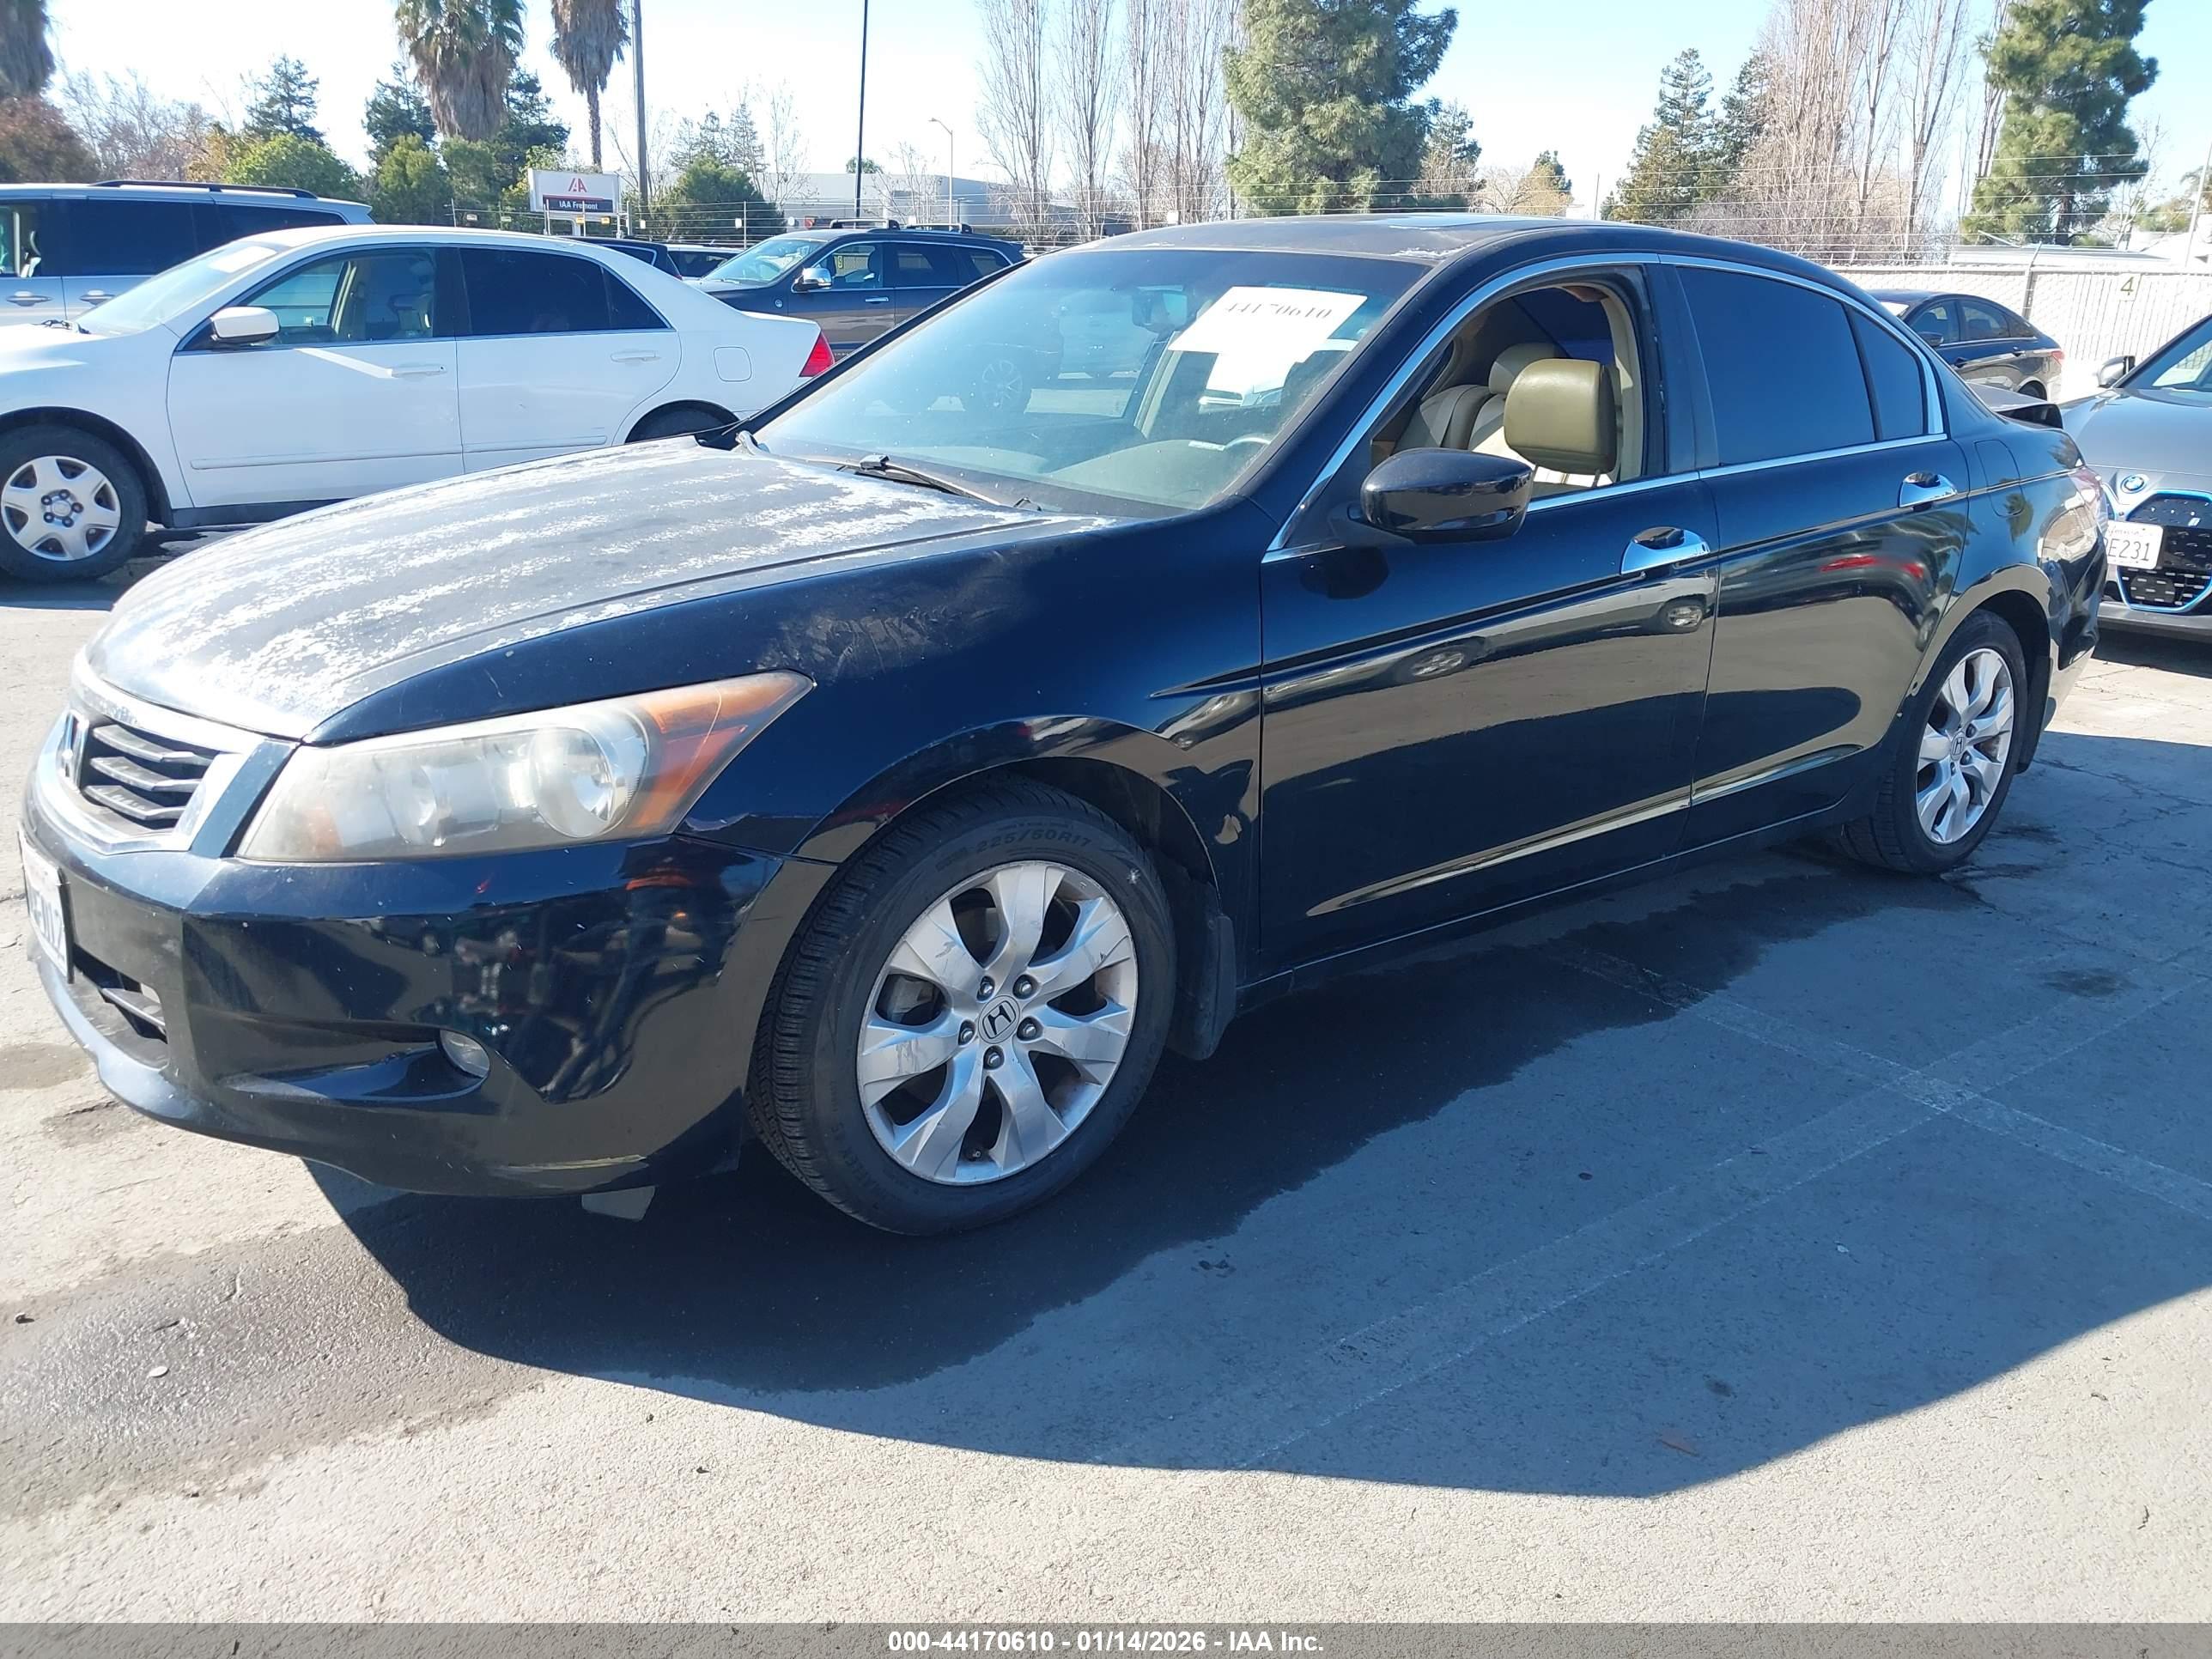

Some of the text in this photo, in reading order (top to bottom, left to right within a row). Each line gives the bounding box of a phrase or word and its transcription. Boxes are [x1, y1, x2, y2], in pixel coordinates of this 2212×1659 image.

[559, 200, 599, 210] IAA Fremont
[2120, 276, 2135, 296] 4
